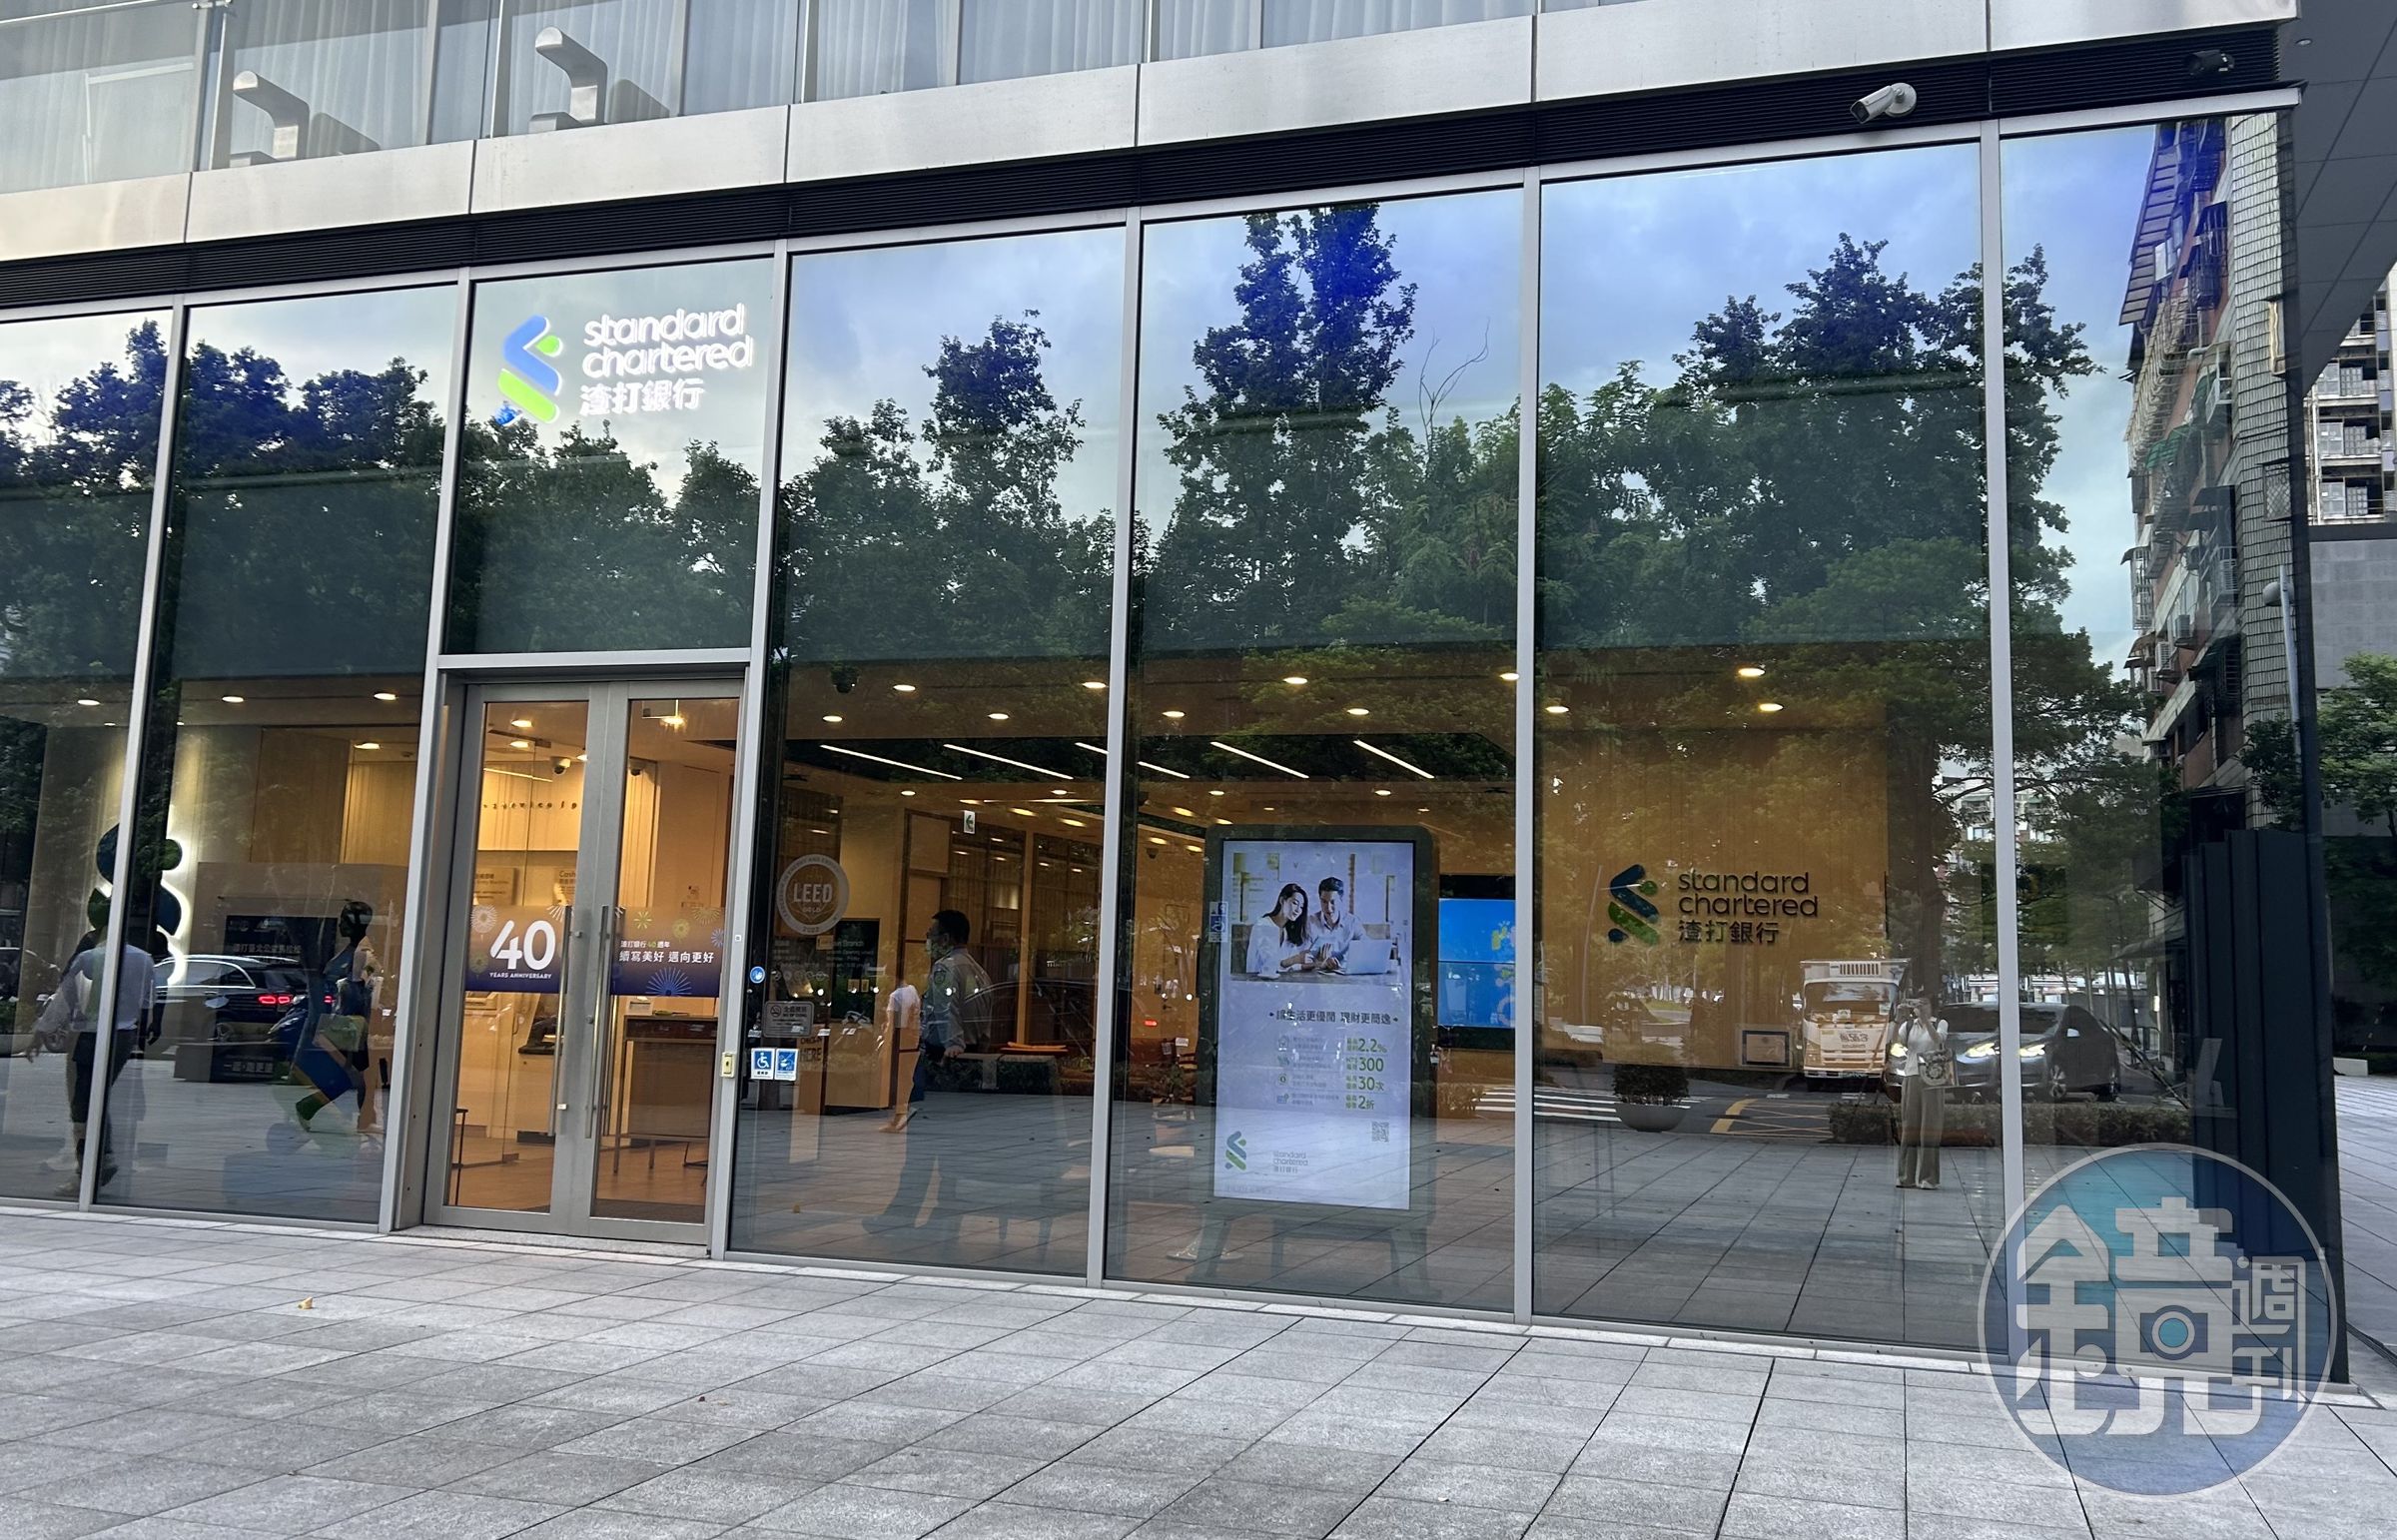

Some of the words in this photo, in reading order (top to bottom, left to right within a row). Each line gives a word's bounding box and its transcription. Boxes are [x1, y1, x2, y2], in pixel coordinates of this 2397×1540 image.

[583, 303, 745, 347] standard
[582, 336, 753, 379] chartered
[579, 379, 704, 416] 渣打銀行
[794, 883, 833, 903] LEED
[1678, 871, 1810, 895] standard
[1678, 894, 1819, 917] chartered
[1678, 919, 1780, 944] 渣打銀行
[489, 920, 556, 970] 40
[1358, 1058, 1384, 1072] 300
